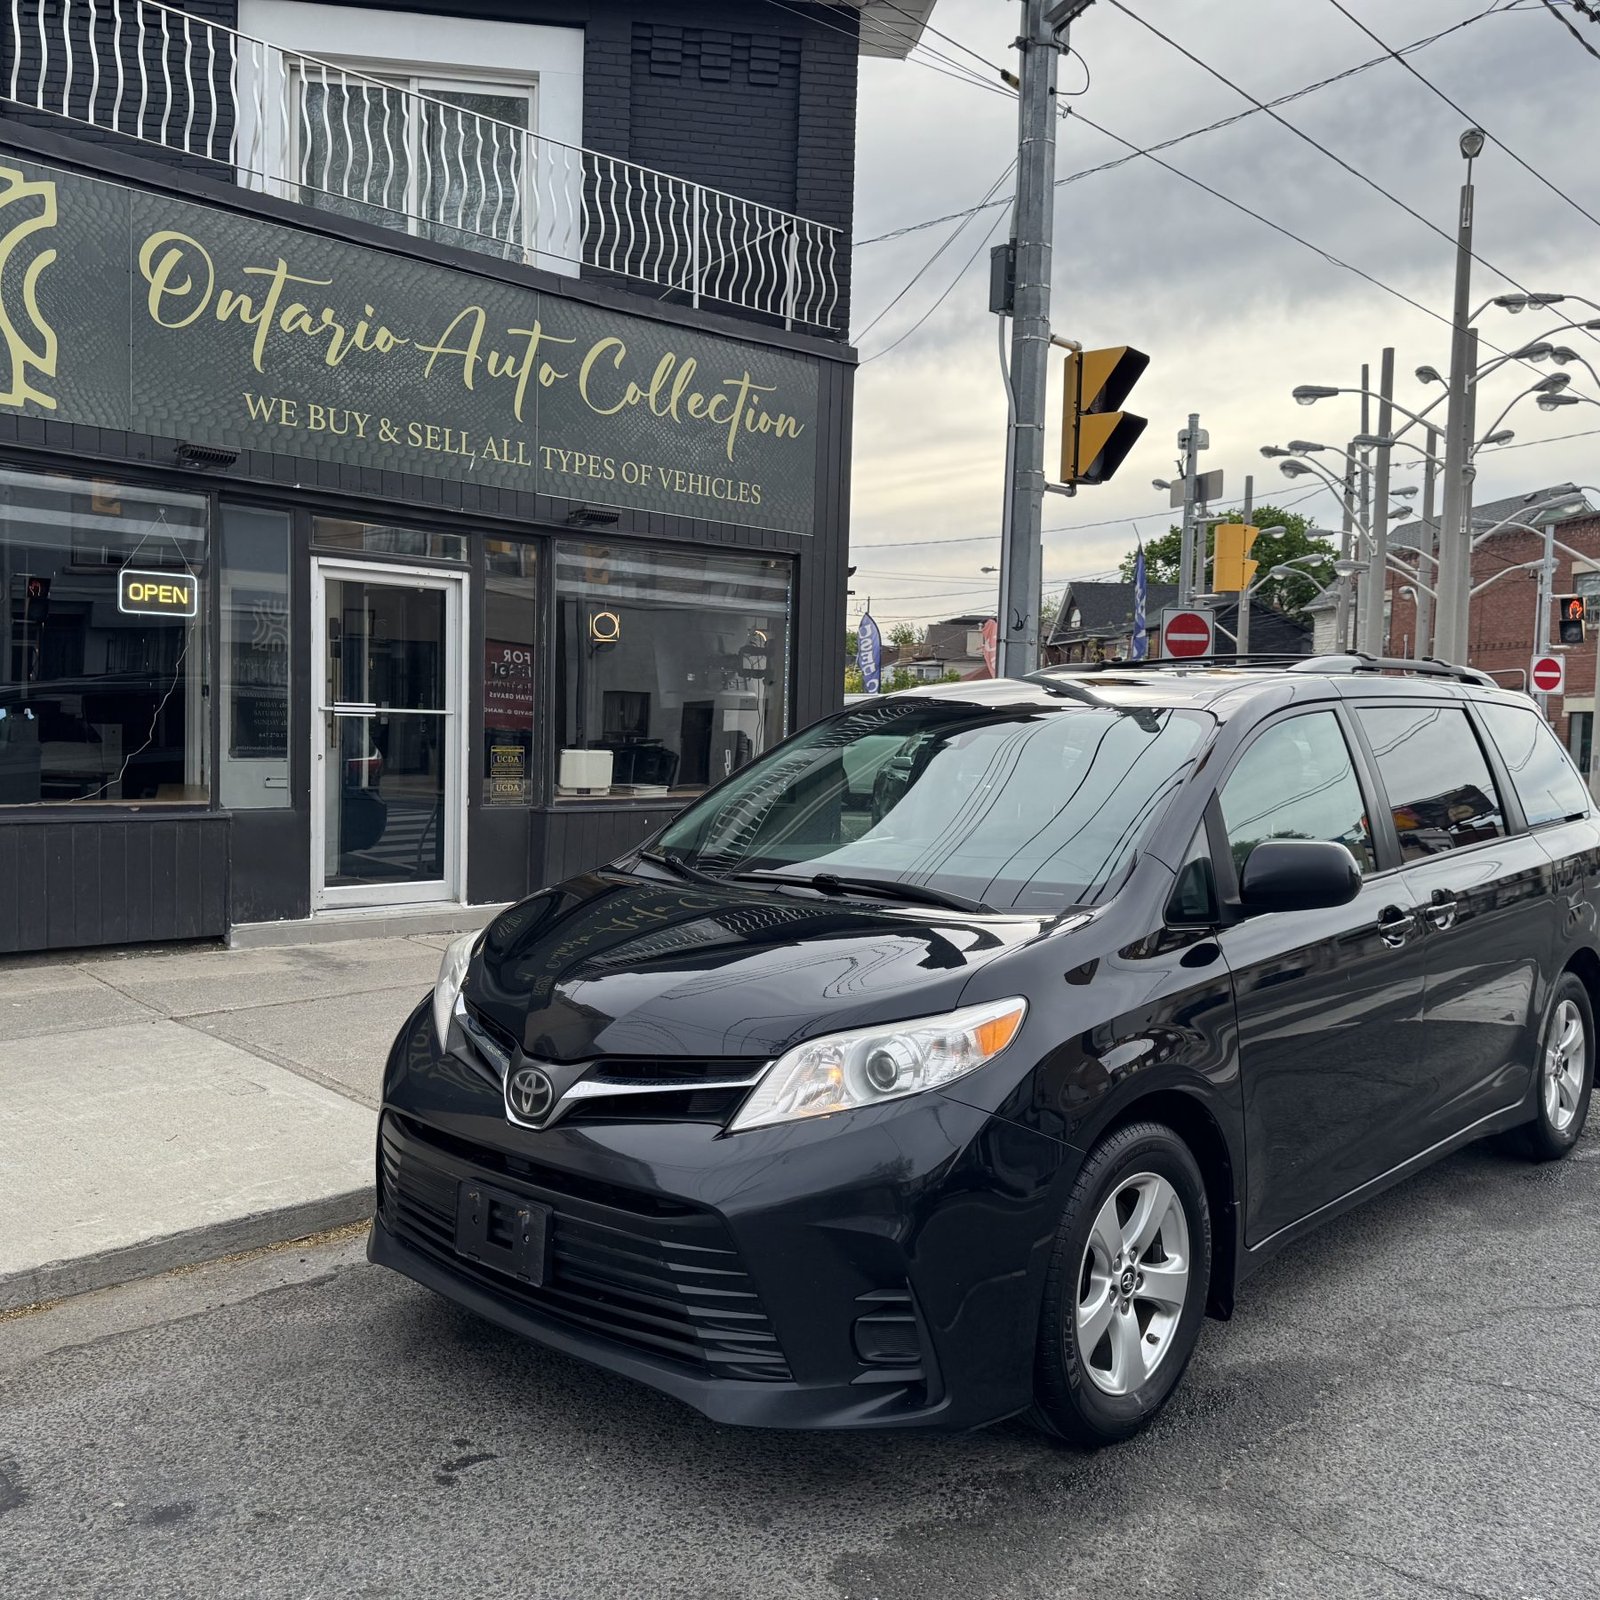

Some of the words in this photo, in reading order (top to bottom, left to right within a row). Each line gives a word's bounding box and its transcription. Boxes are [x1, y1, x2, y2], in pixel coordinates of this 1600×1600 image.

[139, 231, 410, 373] Ontario
[414, 305, 577, 423] Auto
[579, 337, 804, 462] Collection
[243, 392, 298, 427] WE
[308, 404, 371, 438] BUY
[378, 418, 402, 445] &
[407, 422, 476, 457] SELL
[482, 435, 532, 466] ALL
[540, 446, 615, 480] TYPES
[621, 461, 654, 486] OF
[658, 467, 762, 504] VEHICLES
[128, 582, 188, 605] OPEN
[496, 755, 520, 763] UCDA
[496, 784, 520, 792] UCDA
